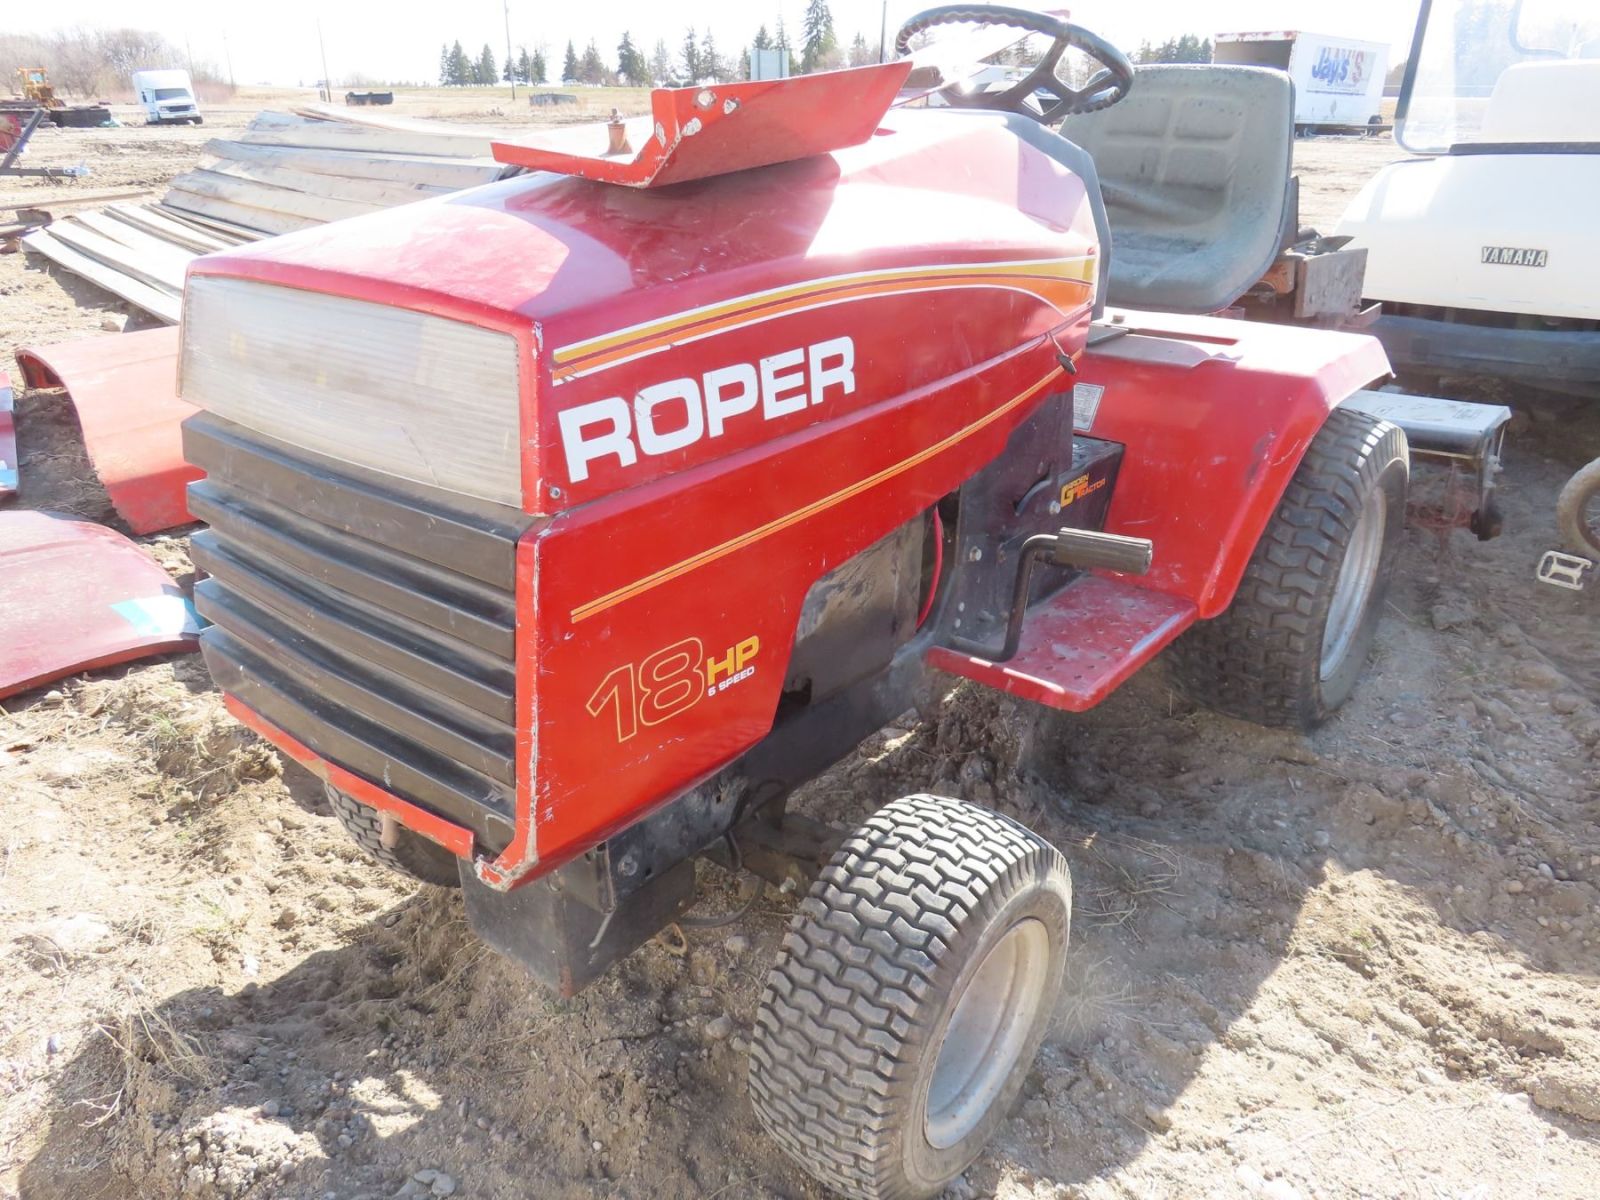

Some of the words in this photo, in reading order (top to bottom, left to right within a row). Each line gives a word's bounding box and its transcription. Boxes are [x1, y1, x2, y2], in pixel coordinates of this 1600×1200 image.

[1481, 247, 1547, 267] YAMAHA
[558, 336, 856, 483] ROPER
[1061, 472, 1089, 507] GARDEN
[1074, 477, 1106, 499] TRACTOR
[586, 637, 705, 743] 18
[707, 635, 760, 686] HP
[708, 686, 716, 697] 6
[718, 666, 755, 691] SPEED
